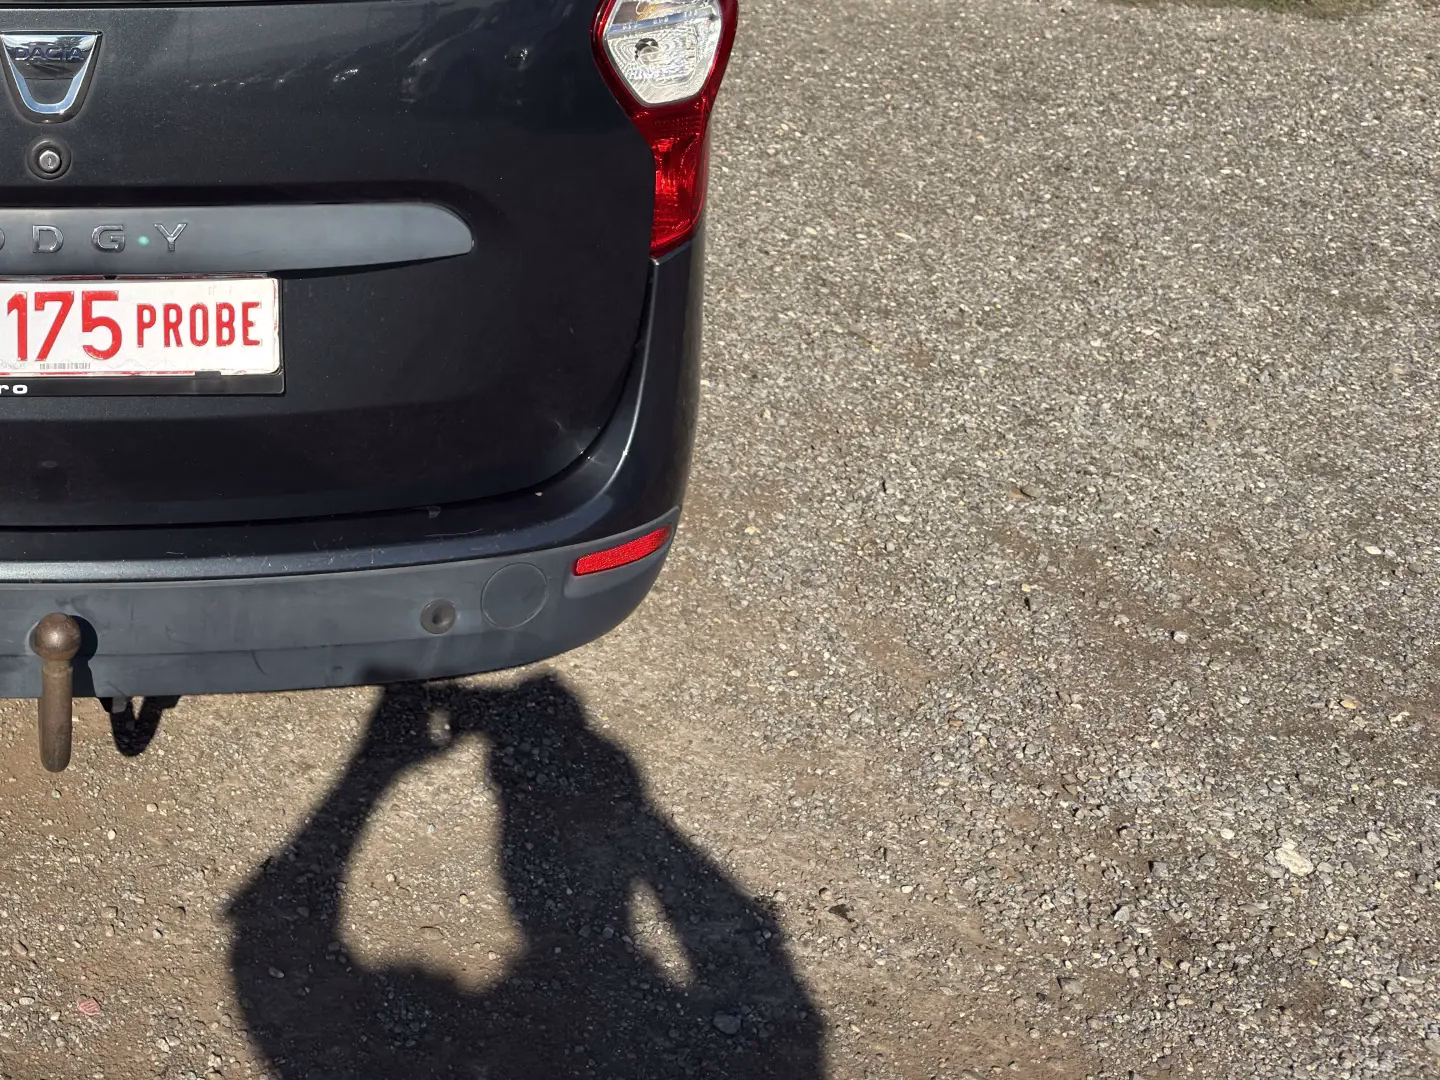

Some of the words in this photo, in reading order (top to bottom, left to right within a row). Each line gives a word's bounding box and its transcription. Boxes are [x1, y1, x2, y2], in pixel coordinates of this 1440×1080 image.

[15, 47, 85, 61] DACIA
[6, 290, 123, 362] 175
[136, 301, 262, 348] PROBE
